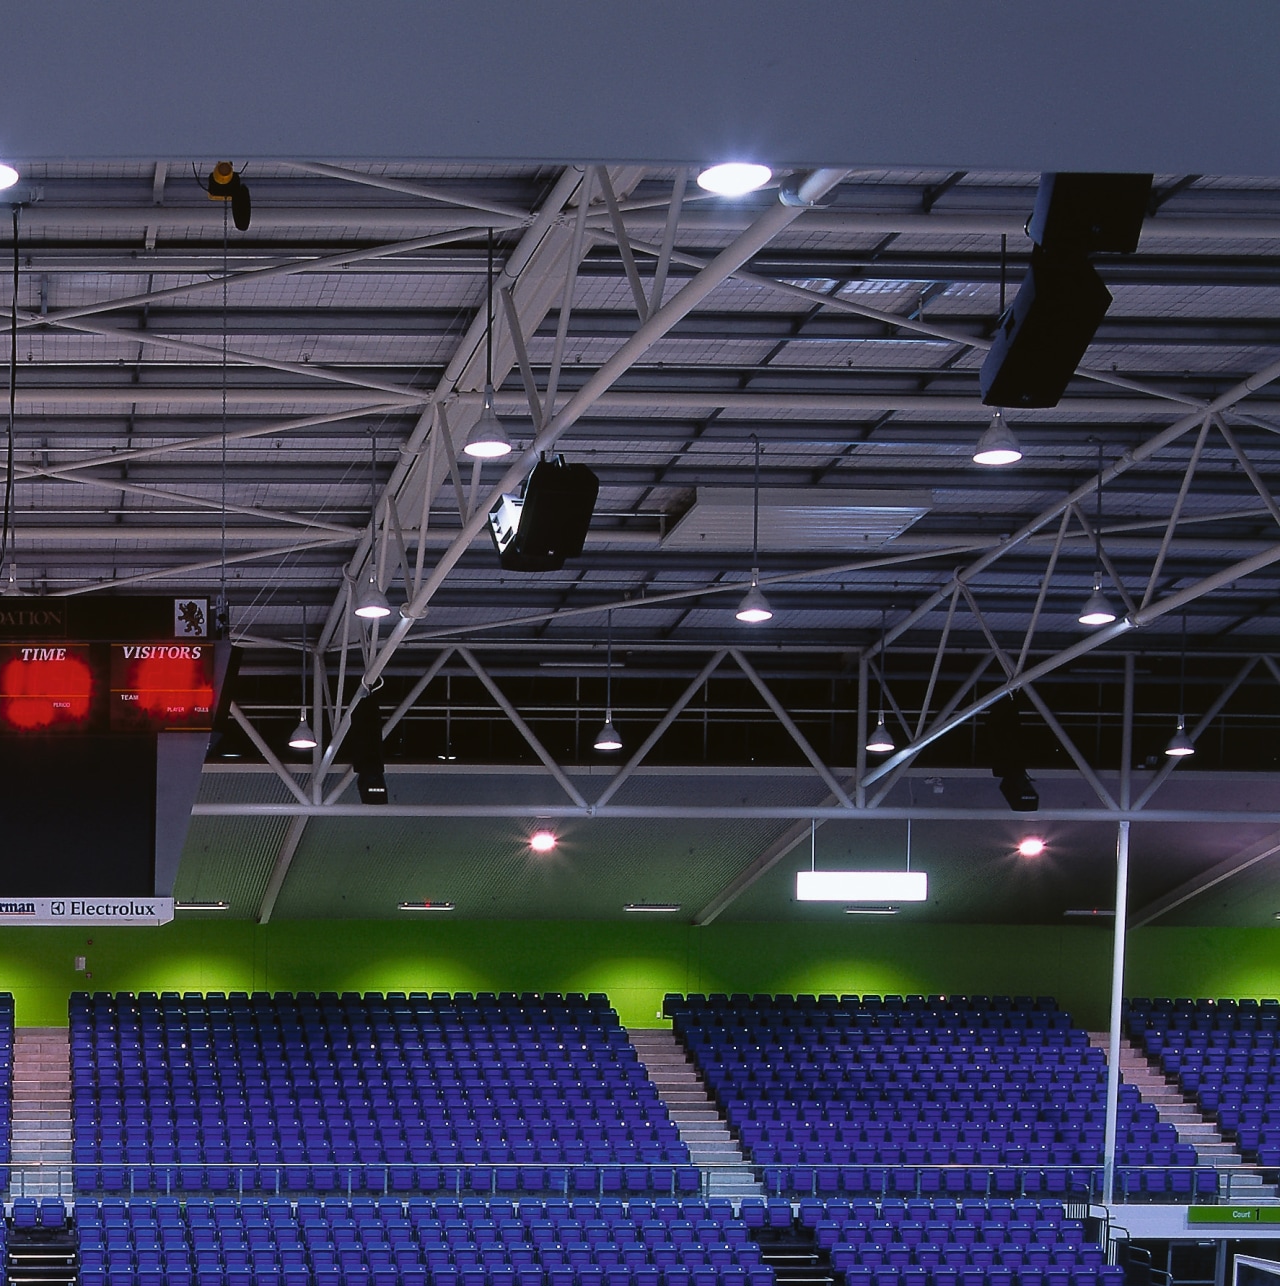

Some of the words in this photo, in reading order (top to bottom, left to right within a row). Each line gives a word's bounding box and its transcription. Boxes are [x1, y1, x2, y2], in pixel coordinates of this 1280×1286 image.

[20, 647, 67, 662] TIME
[122, 646, 202, 660] VISITORS
[70, 901, 156, 916] Electrolux
[1232, 1210, 1251, 1219] Court
[1255, 1208, 1260, 1221] 1
